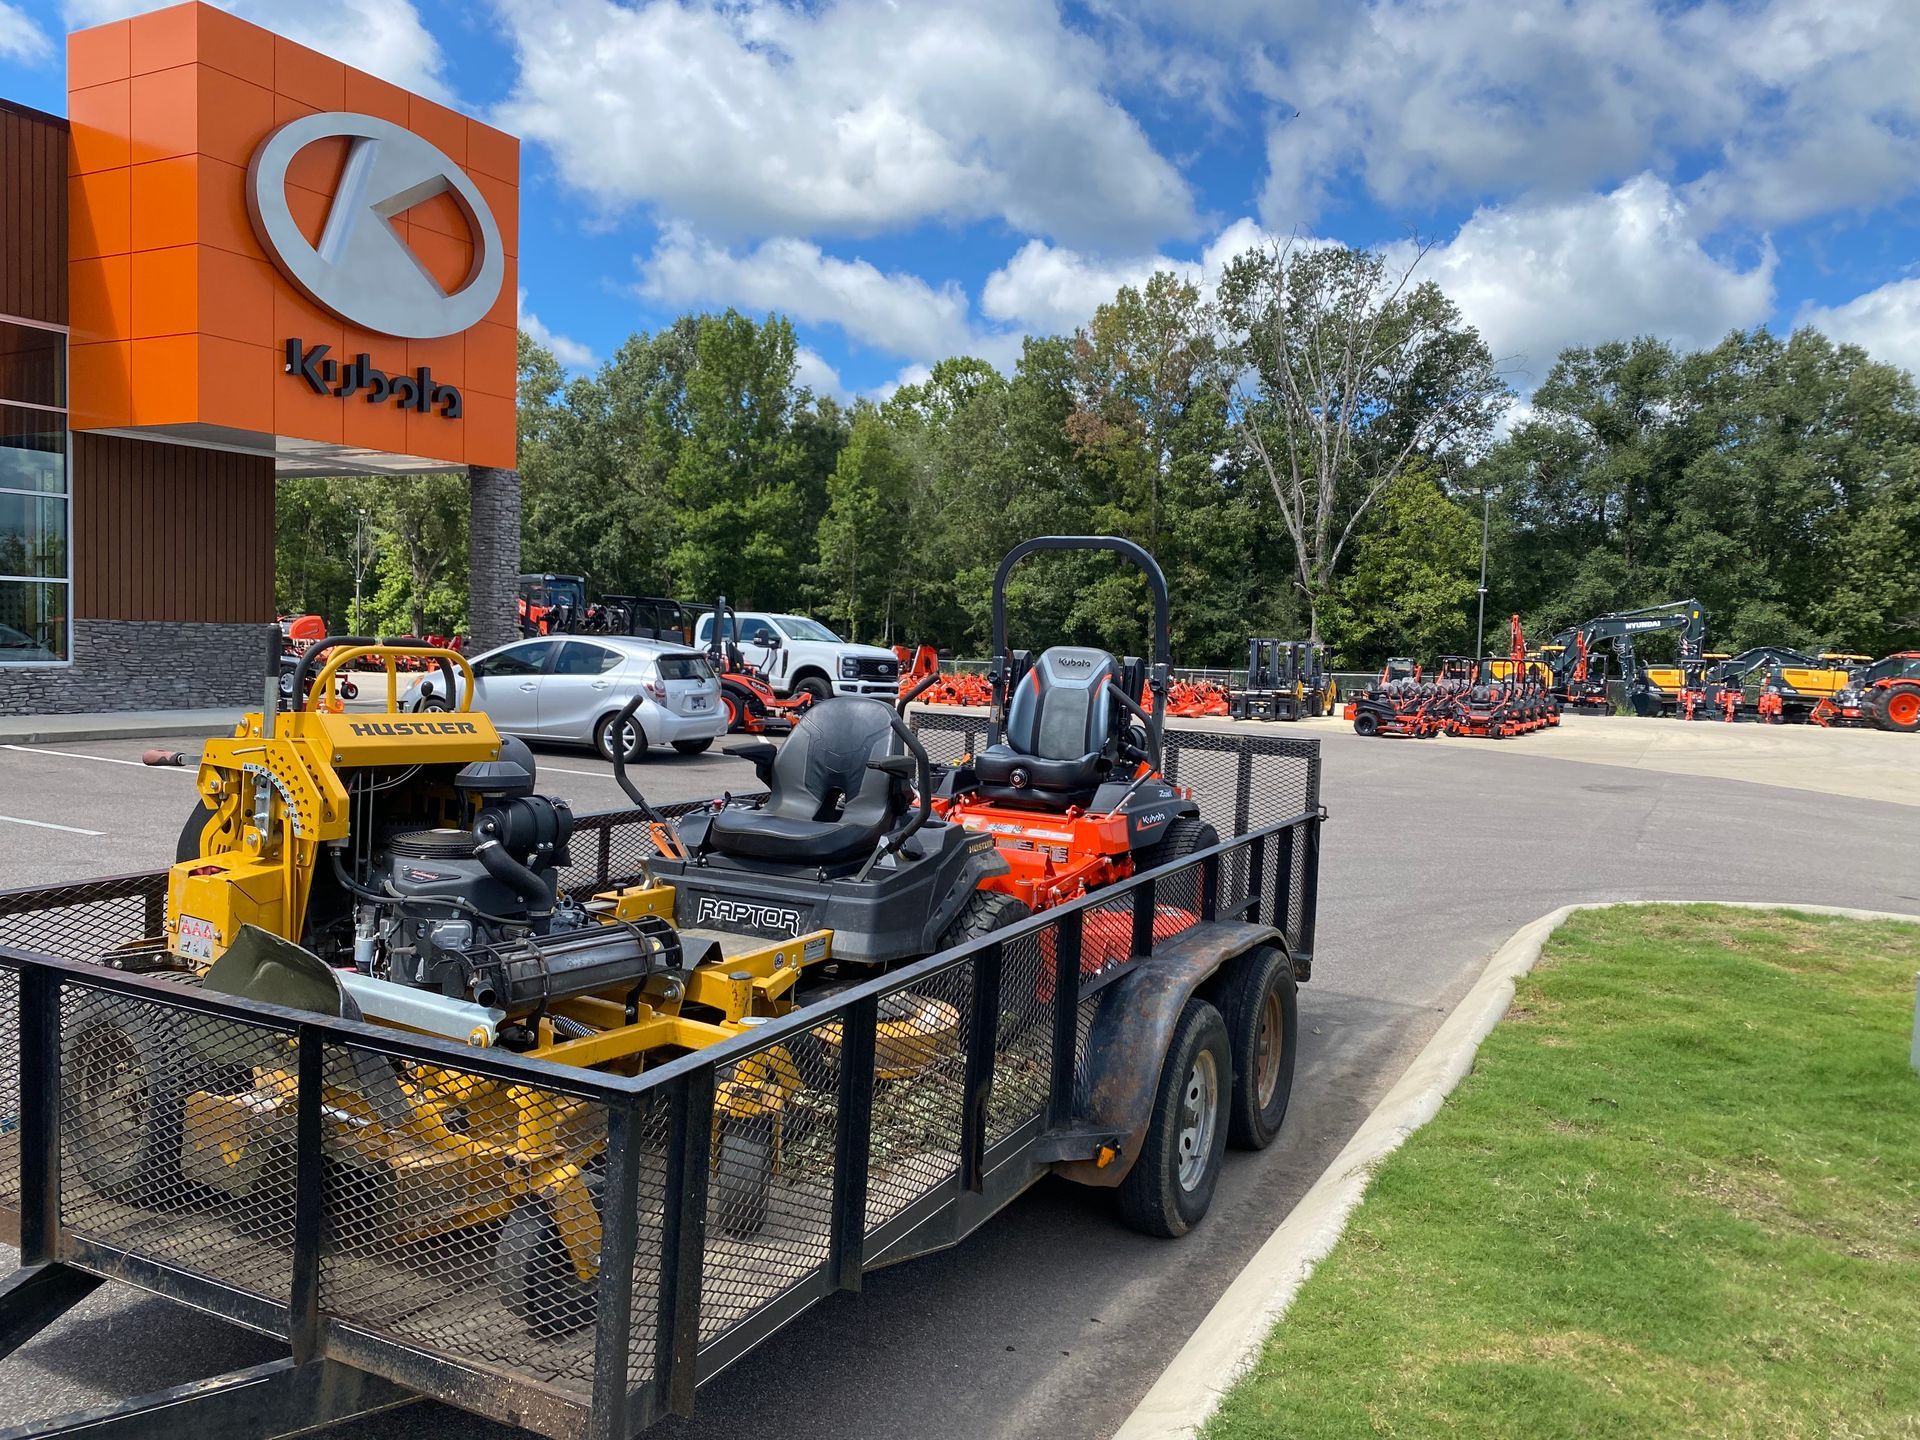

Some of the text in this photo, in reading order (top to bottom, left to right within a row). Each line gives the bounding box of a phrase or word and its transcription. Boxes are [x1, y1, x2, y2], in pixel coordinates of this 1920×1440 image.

[285, 337, 463, 419] Kubota
[1625, 620, 1661, 629] HYUNDAI
[1058, 657, 1091, 667] Kubota
[349, 722, 477, 737] HUSTLER
[1142, 812, 1166, 824] Kubota
[697, 897, 801, 938] RAPTOR
